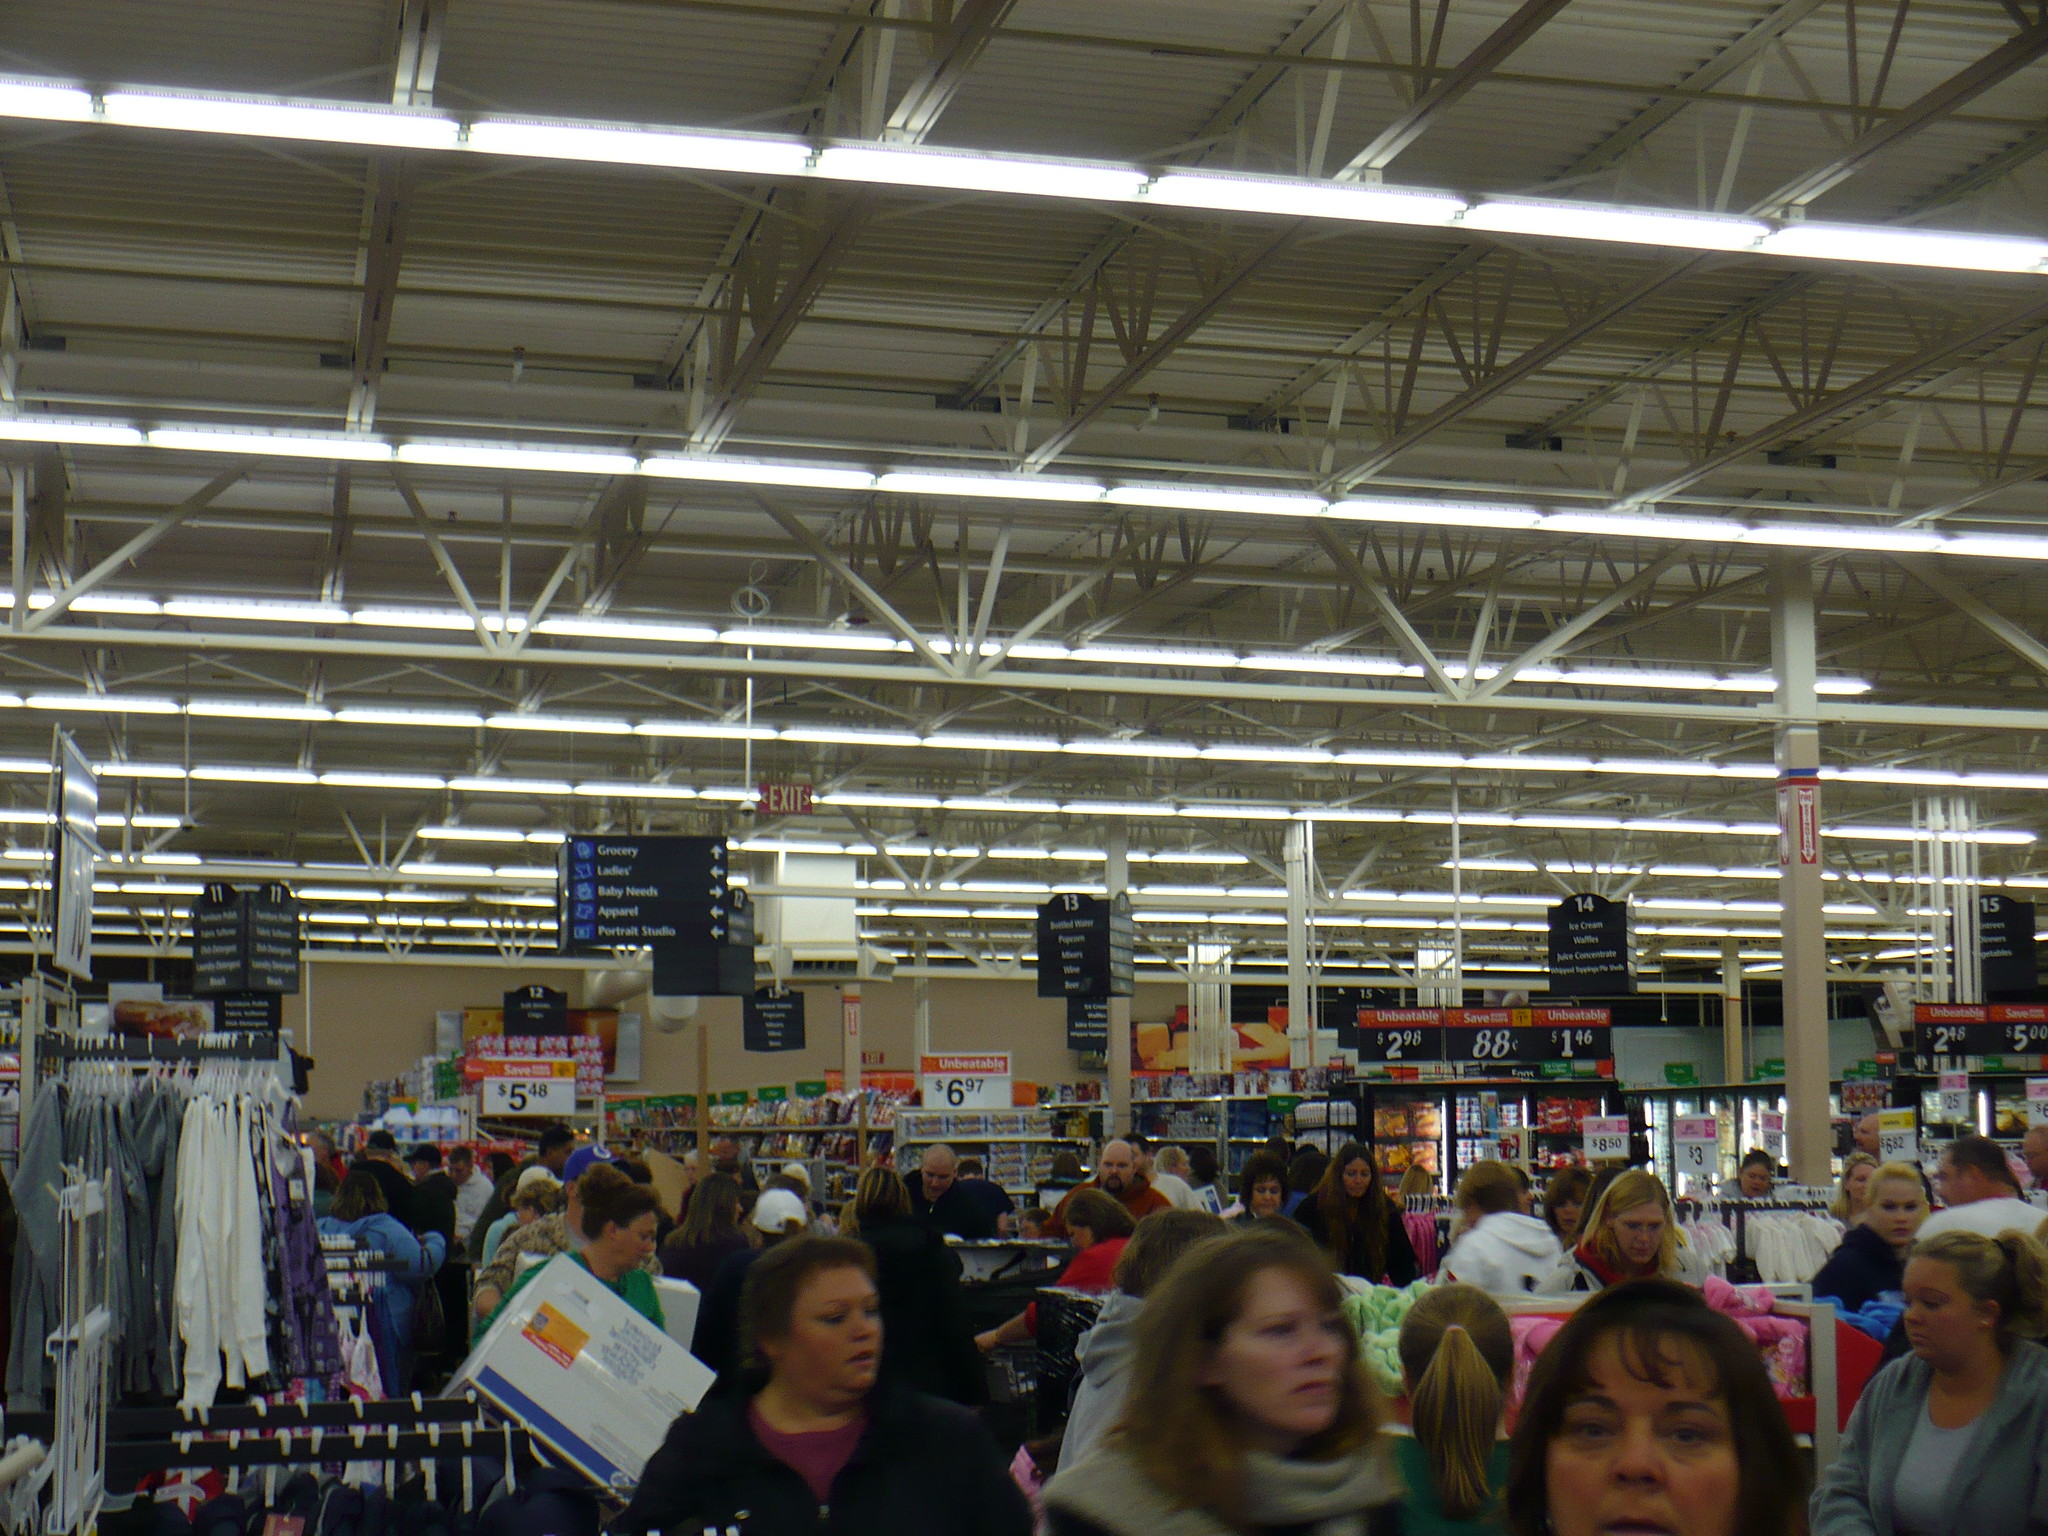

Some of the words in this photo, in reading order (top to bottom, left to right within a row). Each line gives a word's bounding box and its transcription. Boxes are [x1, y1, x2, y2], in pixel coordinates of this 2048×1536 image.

[769, 785, 803, 811] EXIT
[597, 845, 639, 858] Grocery
[597, 865, 632, 876] Ladies'
[210, 884, 223, 903] 11
[270, 884, 282, 903] 11
[598, 886, 624, 899] Baby
[626, 886, 659, 897] Needs
[1062, 894, 1079, 911] 13
[1575, 895, 1595, 913] 14
[1981, 897, 2000, 914] 15
[598, 905, 639, 919] Apparel
[598, 926, 639, 937] Portrait
[641, 926, 677, 937] Studio
[1569, 922, 1580, 931] Ice
[1580, 921, 1604, 931] Cream
[1573, 935, 1600, 945] Waffles
[1557, 952, 1574, 963] Juice
[1574, 950, 1617, 961] Concentrate
[1360, 989, 1373, 999] 15
[1376, 1011, 1439, 1022] Unbeatable
[1463, 1012, 1490, 1024] Save
[1547, 1010, 1607, 1022] Unbeatable
[1930, 1007, 1985, 1018] Unbeatable
[2005, 1008, 2029, 1018] Save
[503, 1063, 531, 1076] Save
[938, 1057, 1004, 1070] Unbeatable
